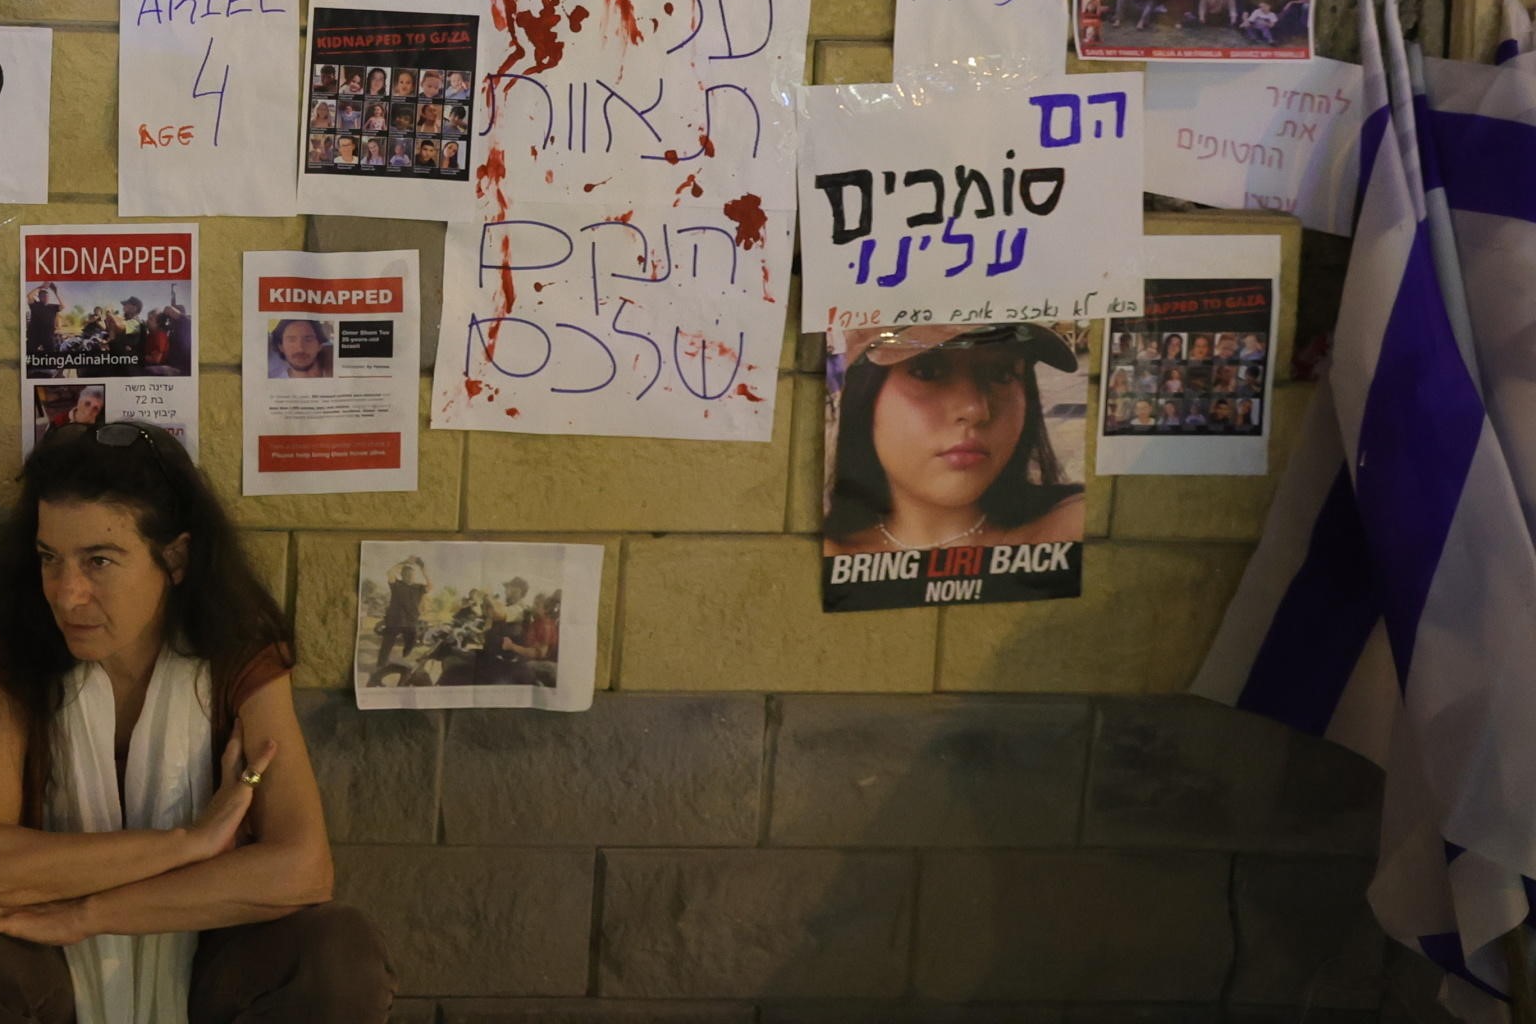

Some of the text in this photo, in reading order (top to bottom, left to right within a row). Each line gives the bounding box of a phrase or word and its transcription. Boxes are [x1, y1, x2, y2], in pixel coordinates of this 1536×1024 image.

[317, 34, 401, 48] KIDNAPPED
[407, 33, 426, 44] TO
[139, 37, 229, 148] AGE 4
[1029, 91, 1127, 148] הם
[1277, 119, 1317, 142] את
[1177, 127, 1284, 169] החטופים
[35, 246, 186, 275] KIDNAPPED
[269, 288, 392, 305] KIDNAPPED
[830, 542, 1073, 585] BRING LIRI BACK
[925, 579, 983, 602] NOW!
